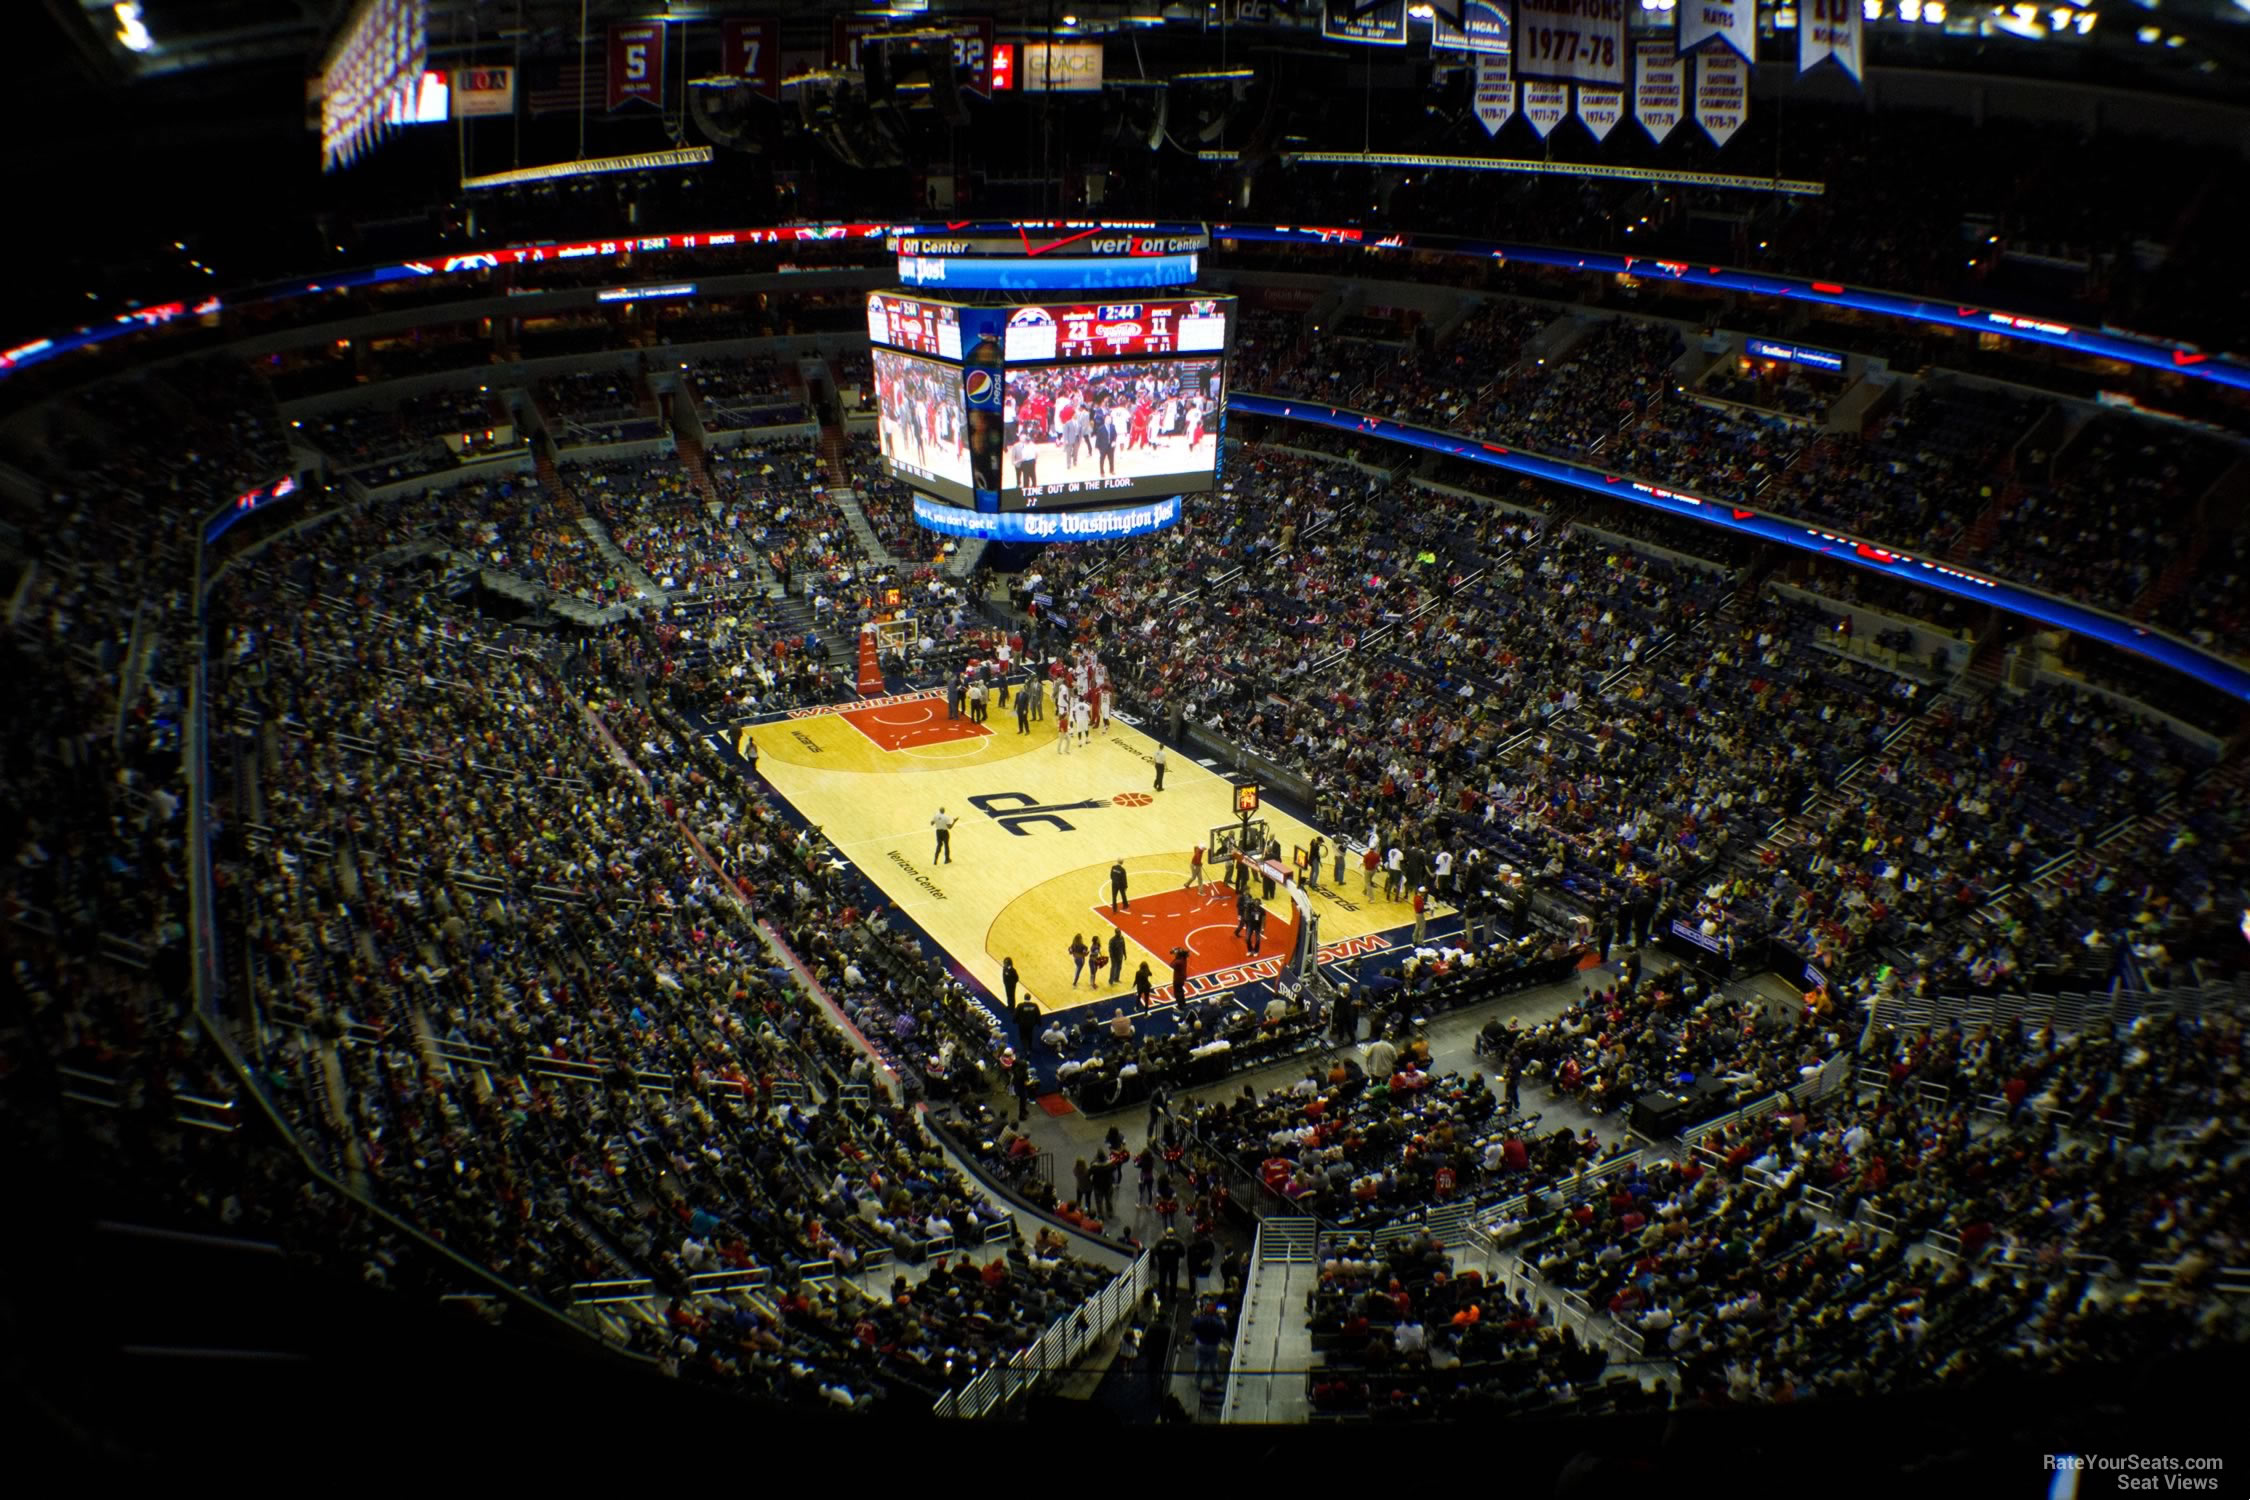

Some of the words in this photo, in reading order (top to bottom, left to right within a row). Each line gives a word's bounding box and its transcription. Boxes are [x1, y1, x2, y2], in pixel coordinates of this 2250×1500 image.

[1472, 21, 1500, 33] NCAA
[1703, 8, 1734, 28] HAYES
[952, 38, 984, 70] 32
[1529, 27, 1615, 67] 1977-78
[626, 43, 646, 79] 5
[743, 40, 760, 75] 7
[1029, 54, 1096, 73] GRACE
[1477, 82, 1512, 92] CONFERENCE
[1639, 85, 1680, 96] CONFERENCE
[1700, 86, 1743, 98] CONFERENCE
[1477, 93, 1511, 104] CHAMPIONS
[1528, 94, 1563, 105] CHAMPIONS
[1582, 95, 1618, 106] CHAMPIONS
[1640, 97, 1679, 108] CHAMPIONS
[1701, 98, 1742, 110] CHAMPIONS
[1531, 108, 1560, 122] 1971-72
[922, 239, 969, 254] Center
[1091, 234, 1164, 256] verizon
[1169, 237, 1201, 251] Center
[917, 257, 946, 284] Post
[1105, 305, 1135, 320] 2:44
[1068, 320, 1089, 340] 23
[1151, 317, 1168, 336] 11
[993, 373, 1002, 405] pepsi
[1022, 487, 1042, 498] TIME
[1048, 484, 1064, 494] OUT
[1069, 483, 1081, 492] ON
[1085, 481, 1100, 491] THE
[1104, 478, 1135, 489] FLOOR.
[948, 514, 968, 527] don't
[969, 519, 986, 530] get
[986, 518, 997, 530] it.
[1024, 513, 1057, 538] The
[1060, 505, 1152, 536] Washington
[1154, 502, 1174, 527] Post
[786, 689, 948, 720] WASHINGTO
[1111, 737, 1144, 760] Verizon
[886, 850, 918, 876] Verizon
[914, 874, 949, 901] Center
